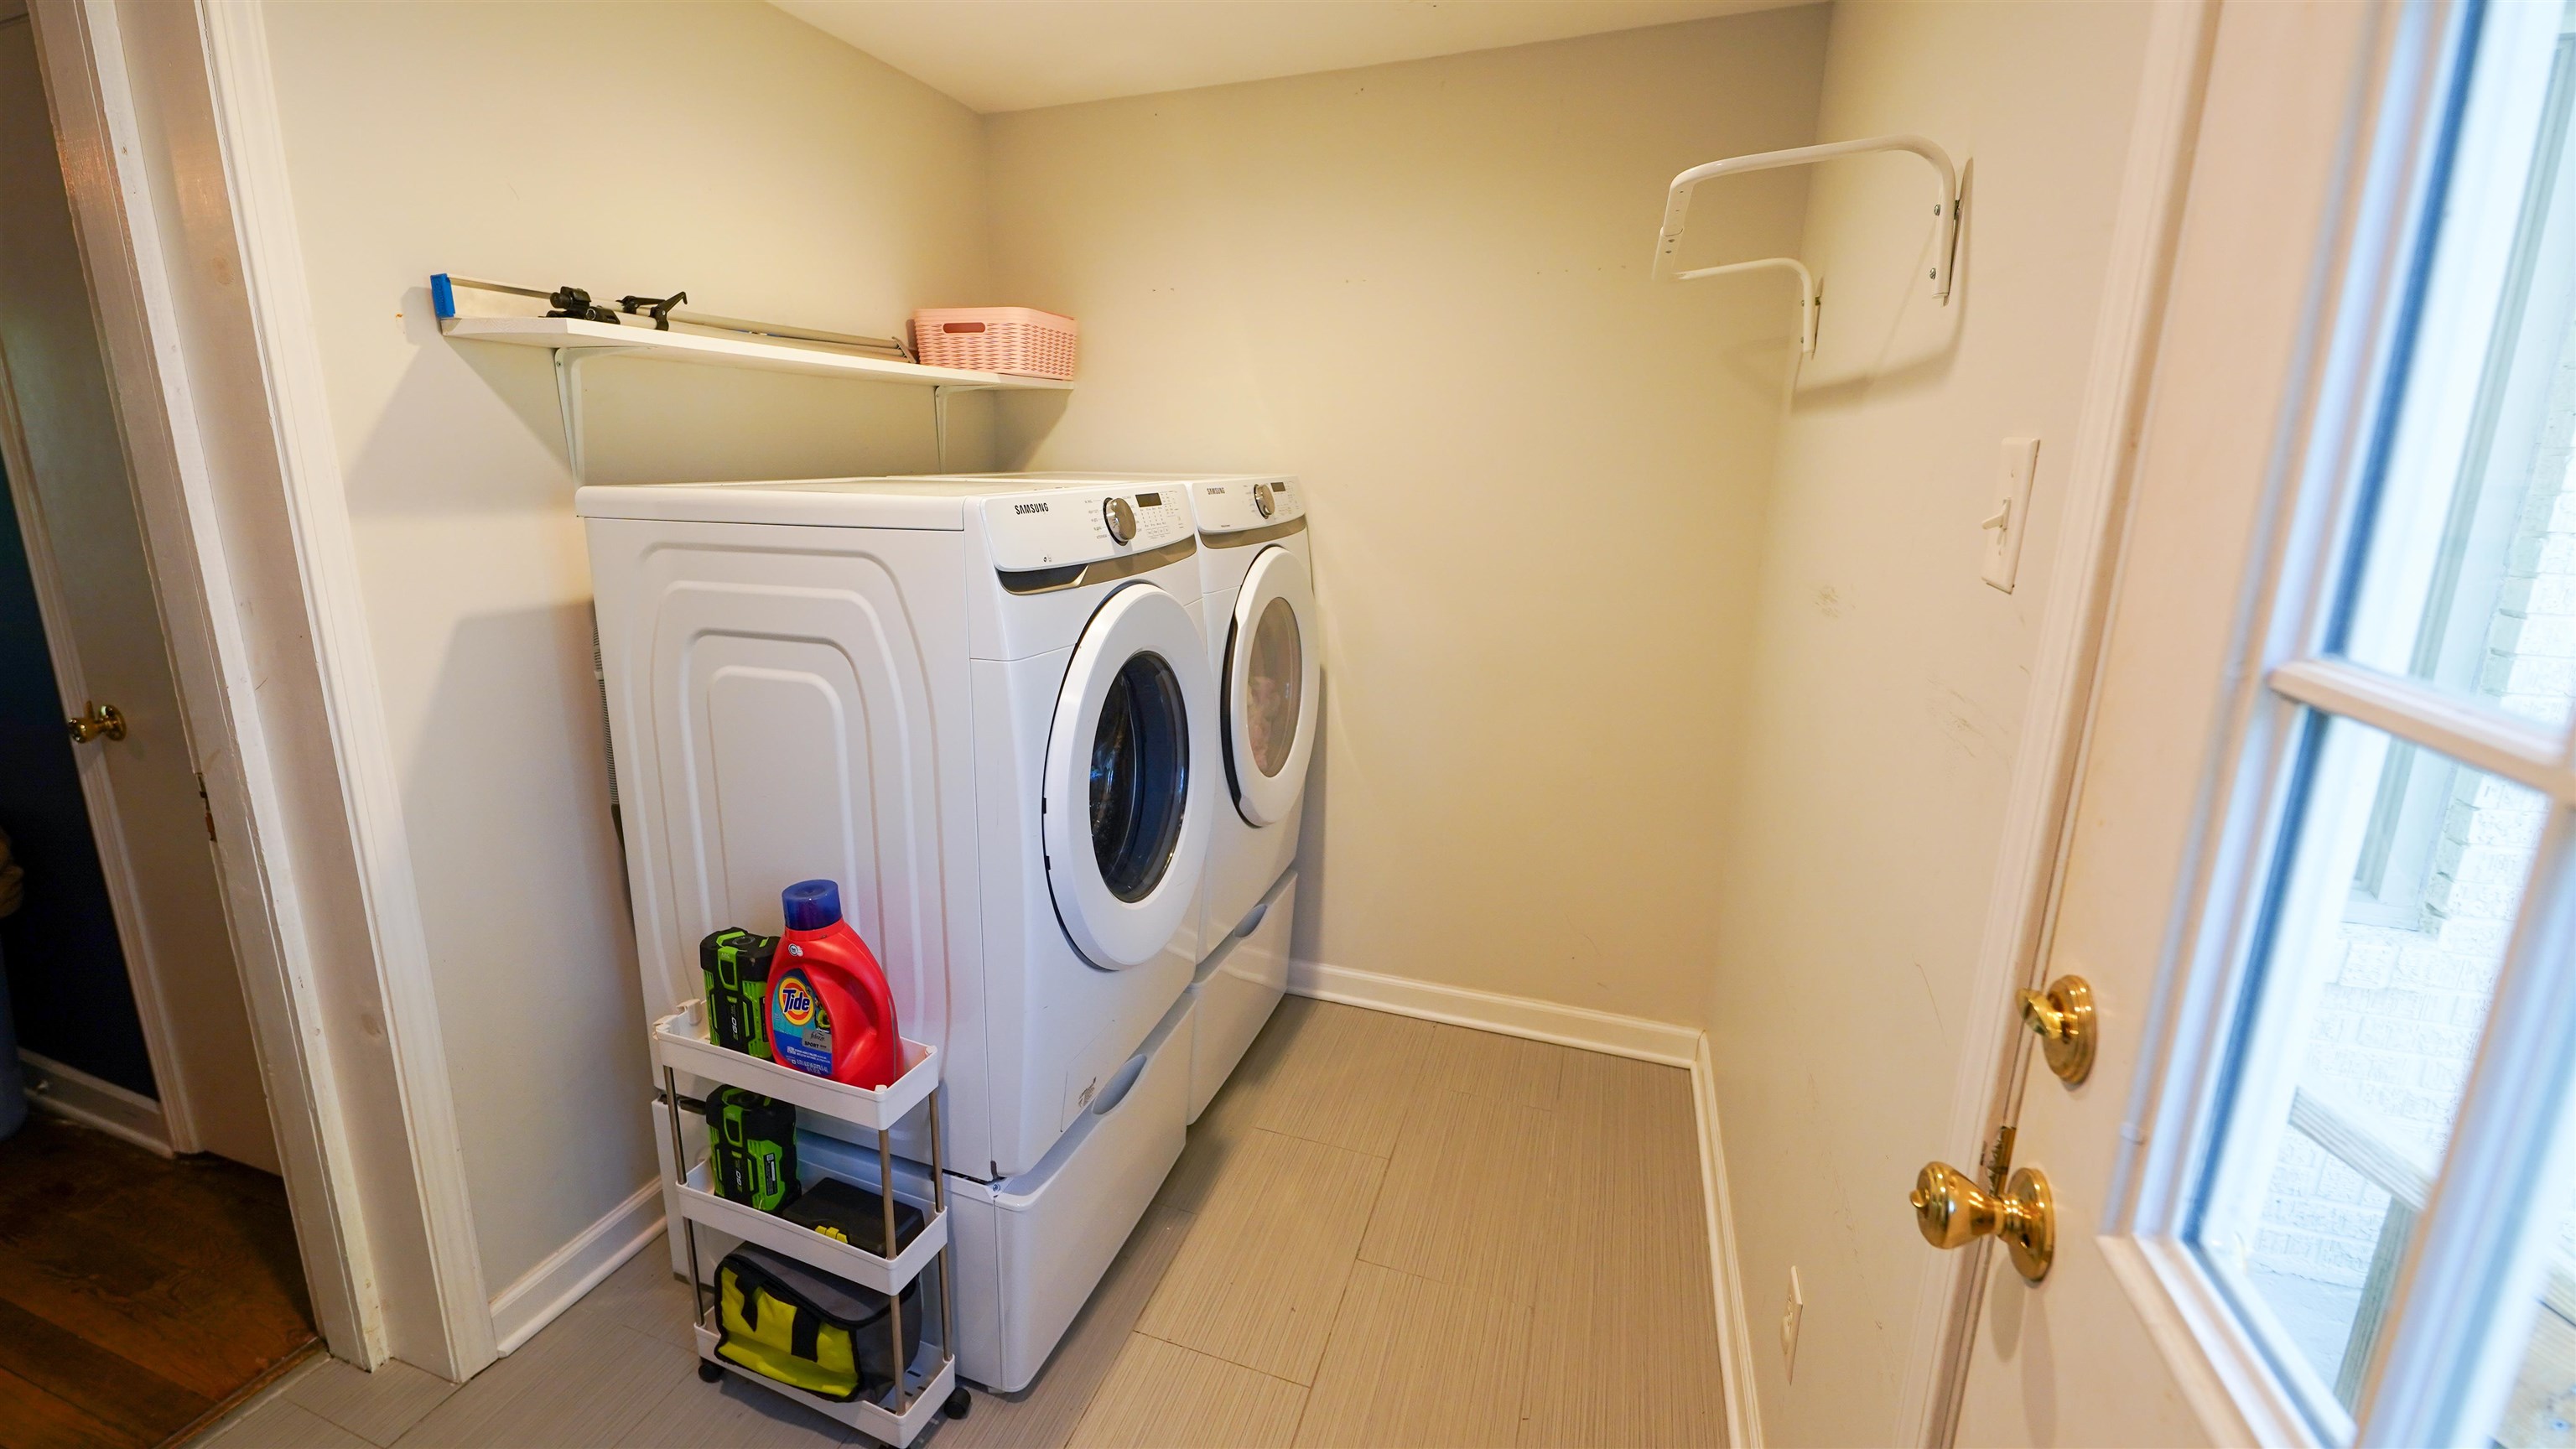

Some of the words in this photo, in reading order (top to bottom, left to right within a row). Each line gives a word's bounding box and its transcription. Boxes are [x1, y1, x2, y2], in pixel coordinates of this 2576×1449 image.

[1207, 486, 1225, 495] SAMSUNG
[1015, 502, 1049, 515] SAMSUNG
[783, 989, 810, 1013] Tide
